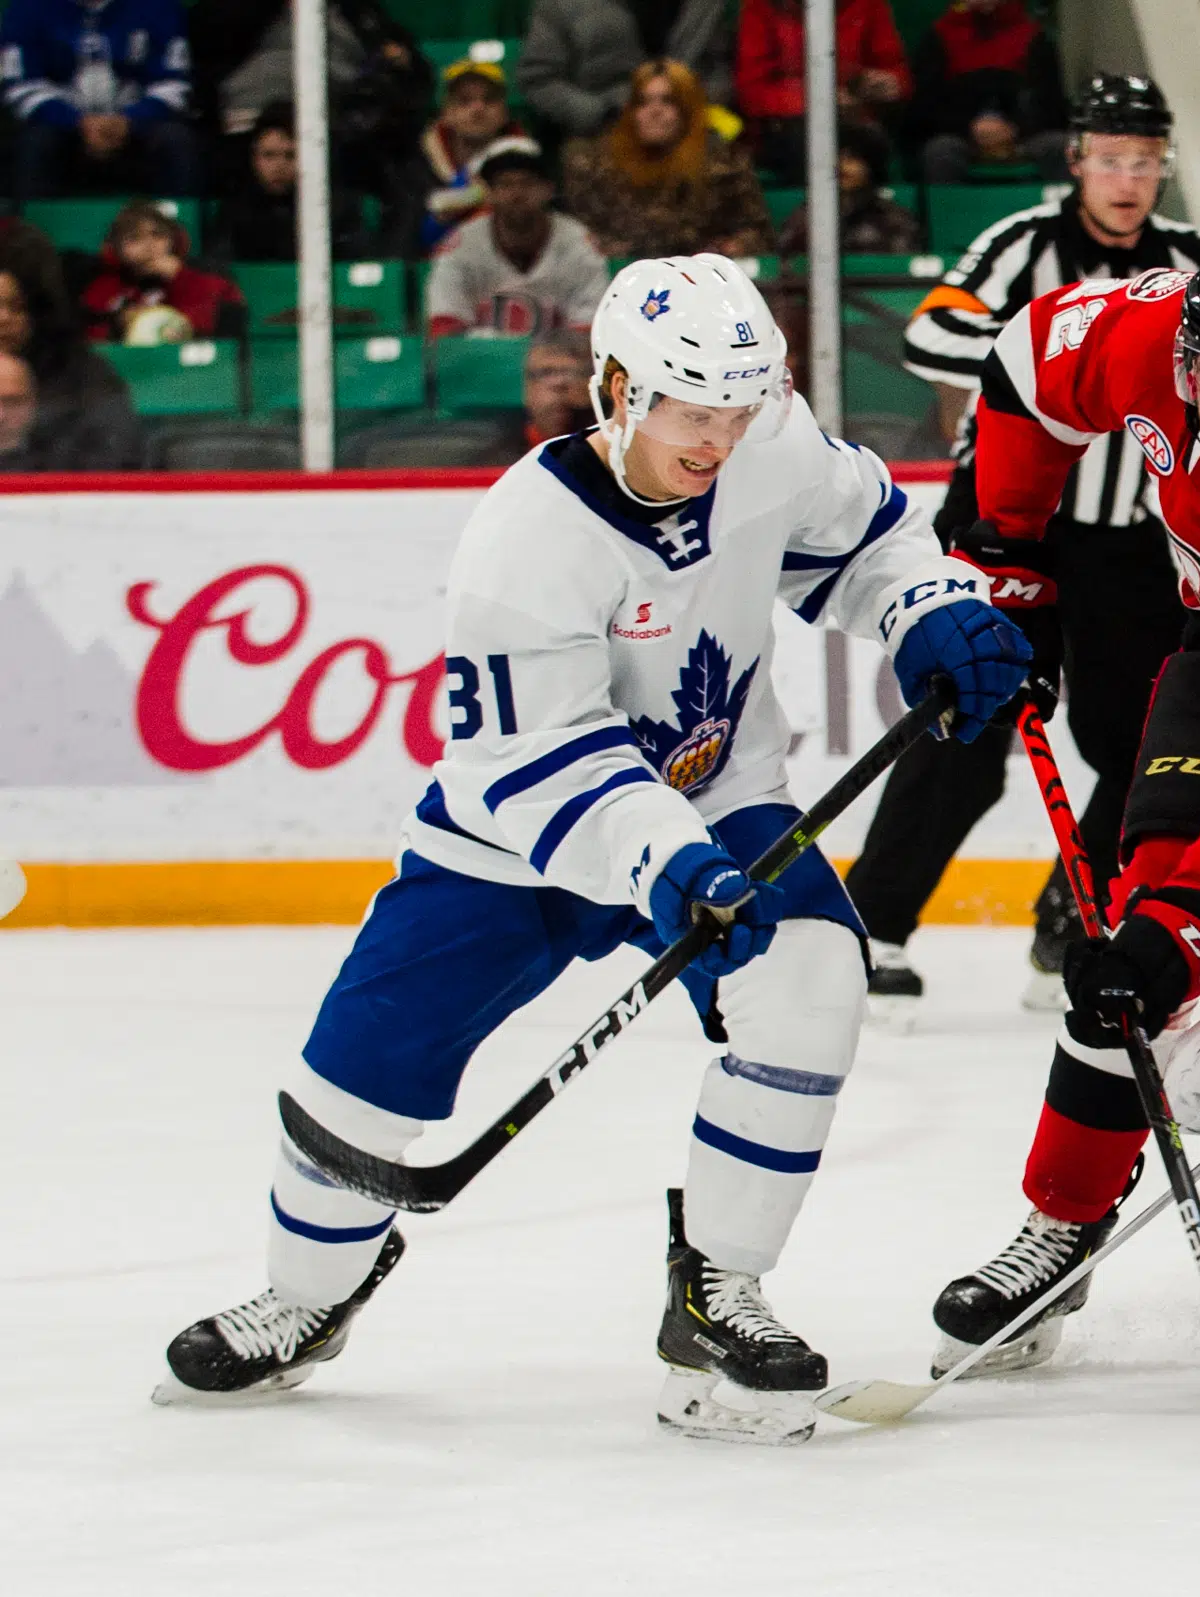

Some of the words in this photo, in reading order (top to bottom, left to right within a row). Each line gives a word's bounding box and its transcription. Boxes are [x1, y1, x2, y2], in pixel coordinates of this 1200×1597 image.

[735, 321, 755, 343] 81
[723, 364, 771, 381] CCM
[1133, 423, 1168, 466] CAA
[879, 578, 978, 643] CCM
[612, 623, 673, 641] Scotiabank
[541, 980, 650, 1097] CCM
